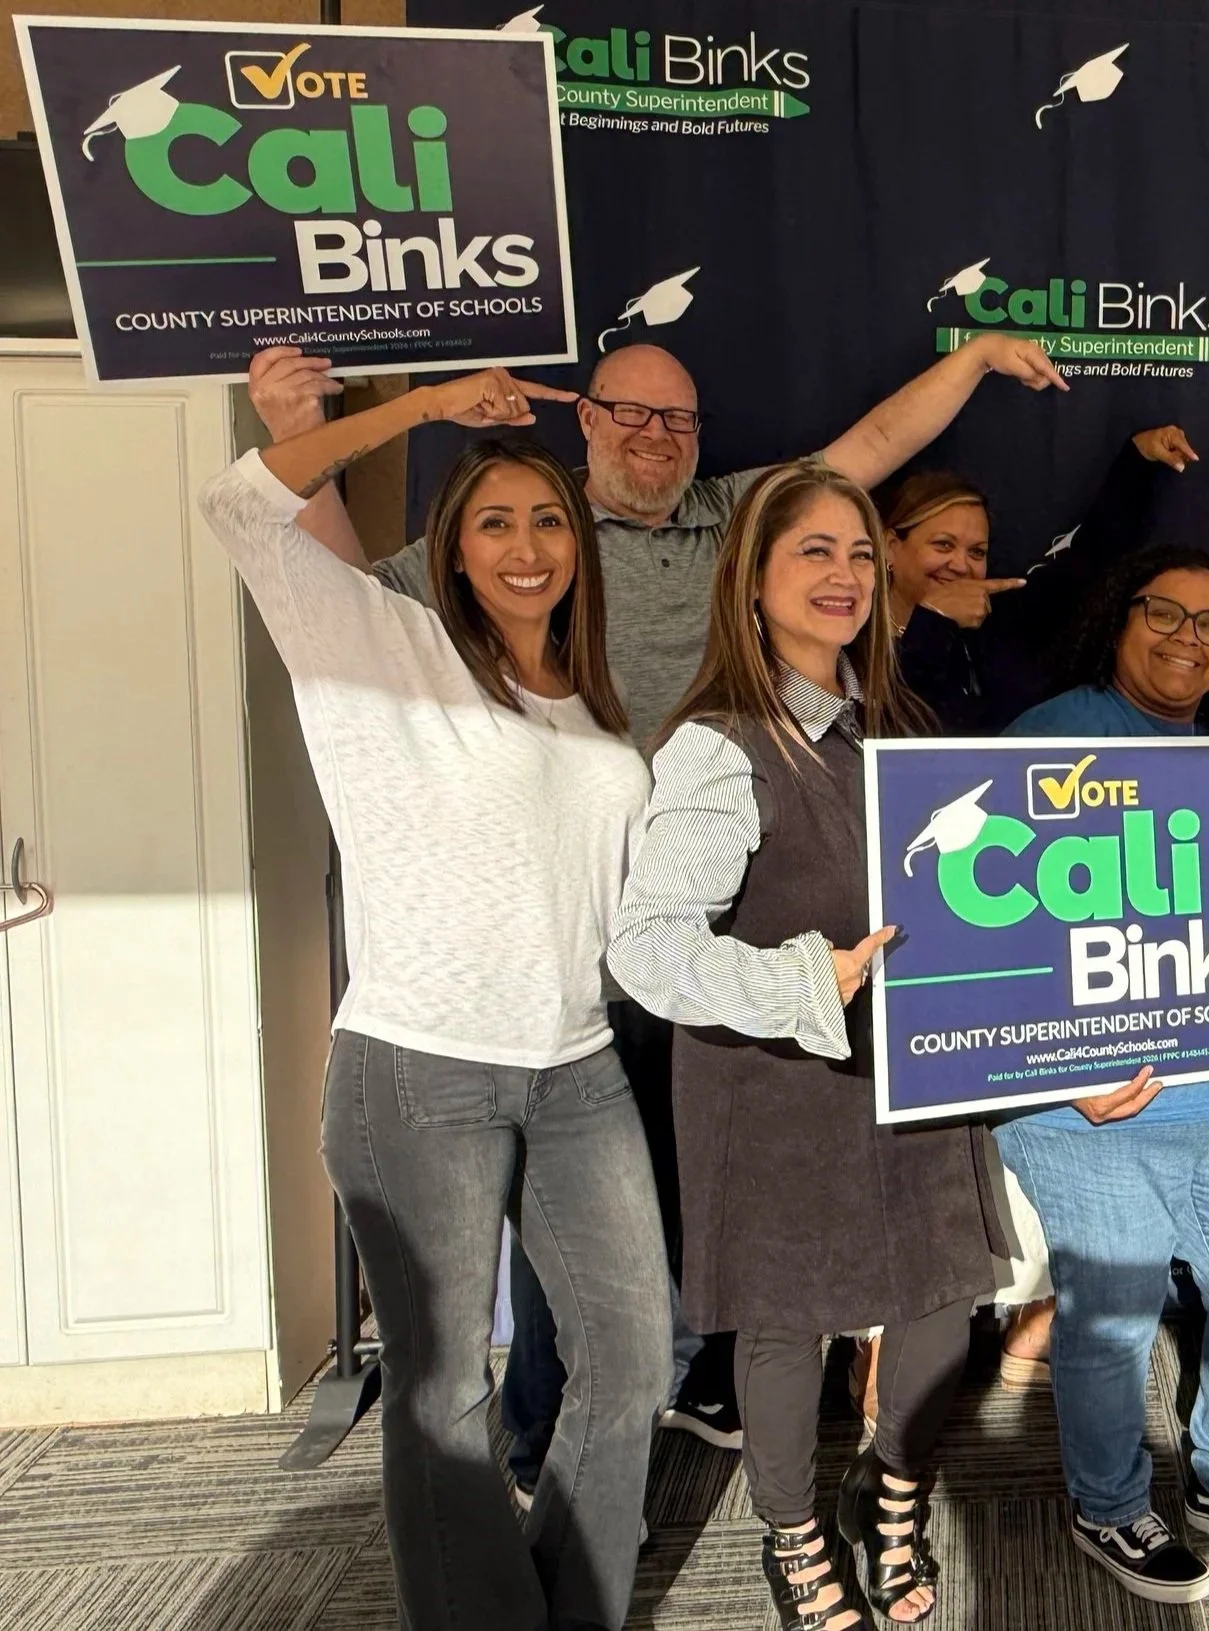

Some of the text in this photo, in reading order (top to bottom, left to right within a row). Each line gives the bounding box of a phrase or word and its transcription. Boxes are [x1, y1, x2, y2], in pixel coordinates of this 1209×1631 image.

[665, 31, 810, 89] Binks
[626, 90, 768, 112] Superintendent
[569, 112, 648, 133] Beginnings
[651, 120, 677, 133] and
[682, 121, 714, 135] Bold
[718, 120, 769, 135] Futures
[125, 103, 453, 216] Cali
[294, 218, 540, 294] Binks
[115, 297, 543, 331] COUNTY SUPERINTENDENT OF SCHOOLS
[965, 277, 1086, 328] Cali
[253, 328, 430, 346] www.Cali4CountySchools.com
[1060, 336, 1194, 356] Superintendent
[1084, 363, 1108, 376] and
[1111, 363, 1141, 377] Bold
[1143, 364, 1193, 378] Futures
[937, 808, 1202, 928] Cali
[910, 1028, 997, 1055] COUNTY
[1000, 1010, 1163, 1045] SUPERINTENDENT
[1166, 1009, 1192, 1027] OF
[1026, 1038, 1178, 1065] www.Cali4CountySchools.com
[1015, 1070, 1023, 1080] by
